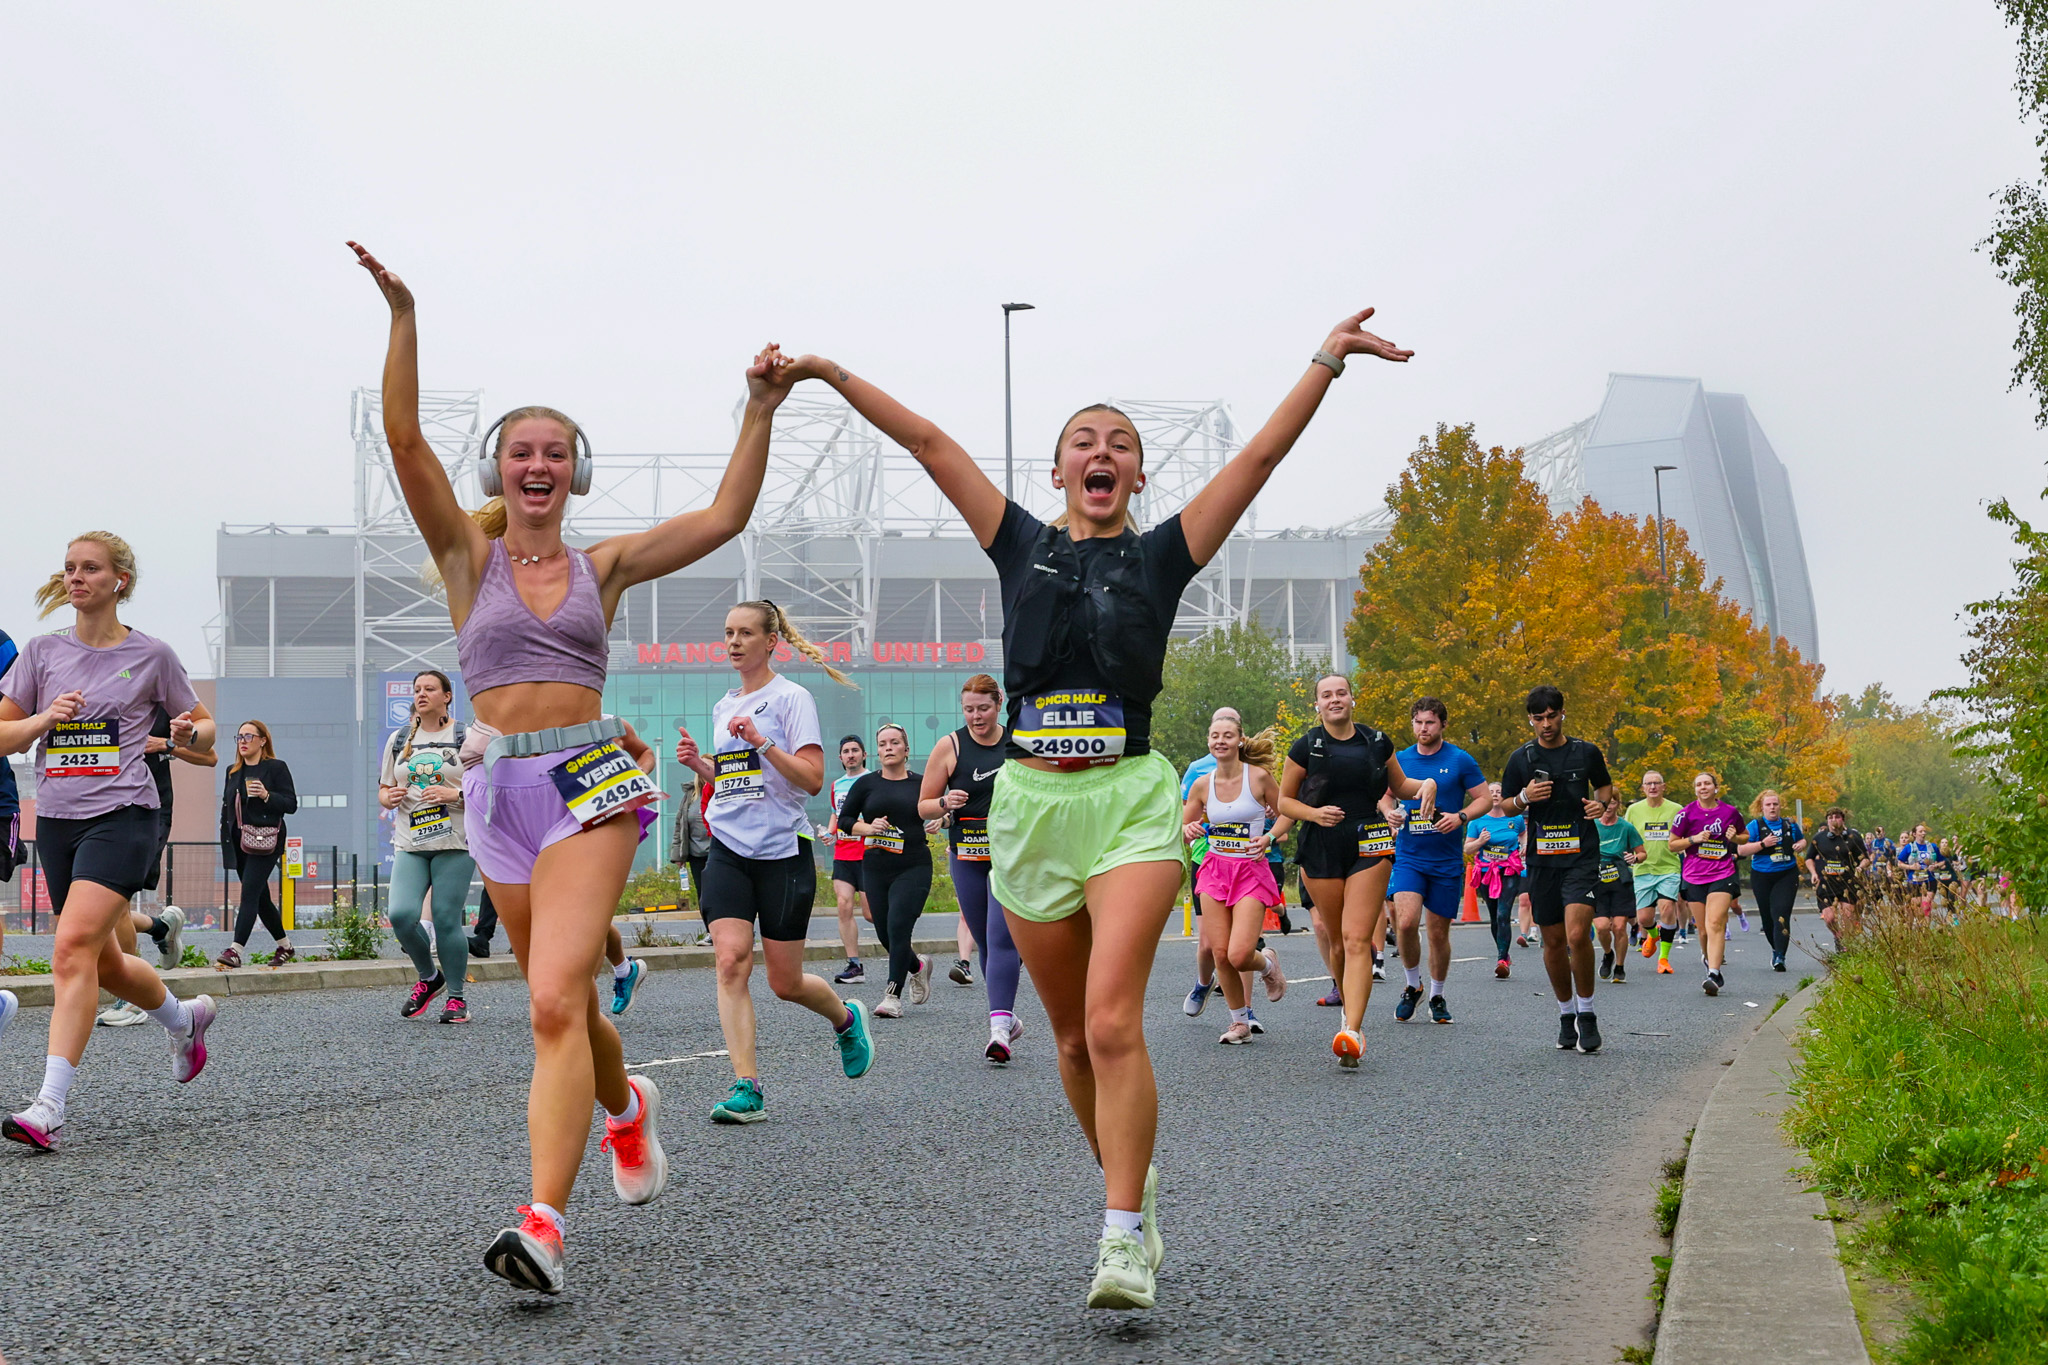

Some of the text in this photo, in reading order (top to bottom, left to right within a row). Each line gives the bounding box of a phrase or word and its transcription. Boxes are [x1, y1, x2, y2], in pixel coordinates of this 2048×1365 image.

[637, 641, 985, 663] MANCSER UNITED
[1045, 693, 1107, 706] MCR HALF
[1042, 710, 1095, 726] ELLIE
[81, 722, 107, 730] HALF
[53, 734, 111, 746] HEATHER
[1032, 738, 1106, 754] 24900
[60, 754, 99, 766] 2423
[576, 747, 604, 767] MCR
[577, 756, 634, 788] VERITY
[720, 761, 748, 774] JENNY
[722, 777, 750, 790] 15776
[592, 778, 651, 812] 24943
[418, 823, 444, 835] 27925
[1367, 829, 1390, 839] KELCI
[872, 838, 896, 847] 23031
[1216, 840, 1241, 848] 29614
[1368, 841, 1394, 851] 22779
[966, 847, 990, 855] 2265
